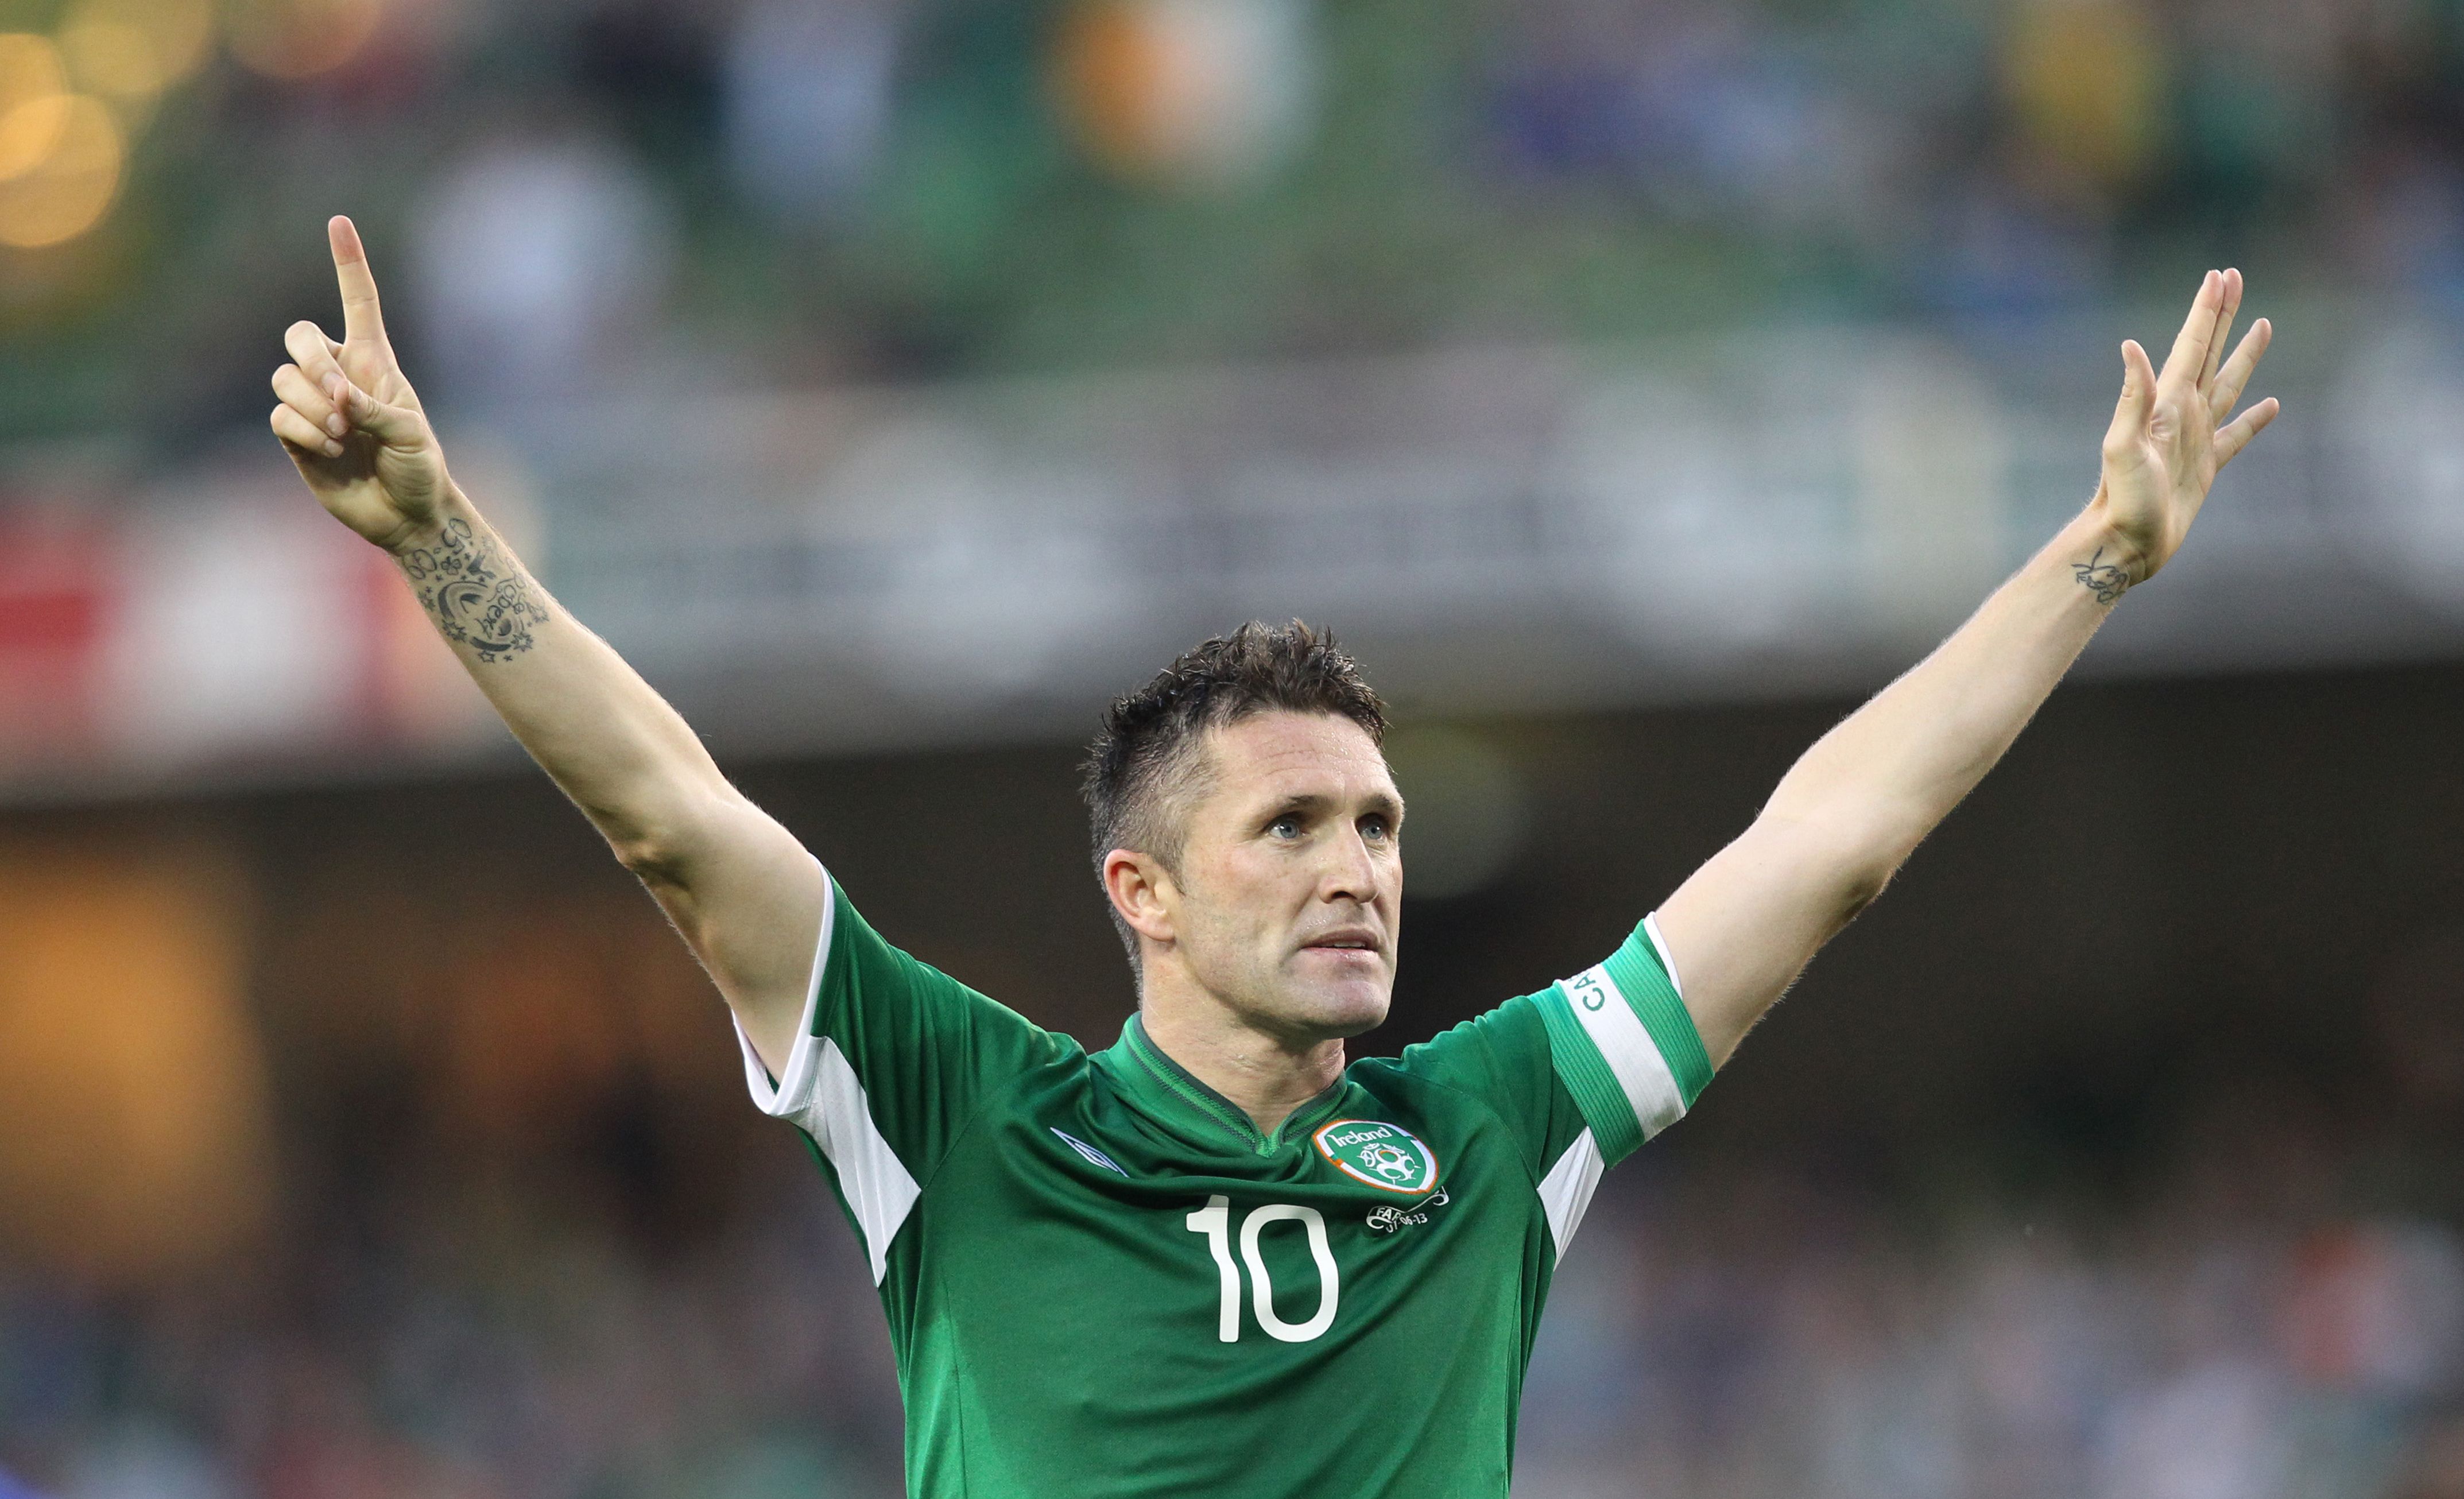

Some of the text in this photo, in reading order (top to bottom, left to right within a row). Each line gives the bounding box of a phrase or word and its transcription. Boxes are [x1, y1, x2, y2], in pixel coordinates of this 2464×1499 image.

[1567, 970, 1606, 1012] CA
[1327, 1126, 1393, 1148] Ireland
[1376, 1207, 1402, 1221] FAR
[1186, 1194, 1339, 1343] 10
